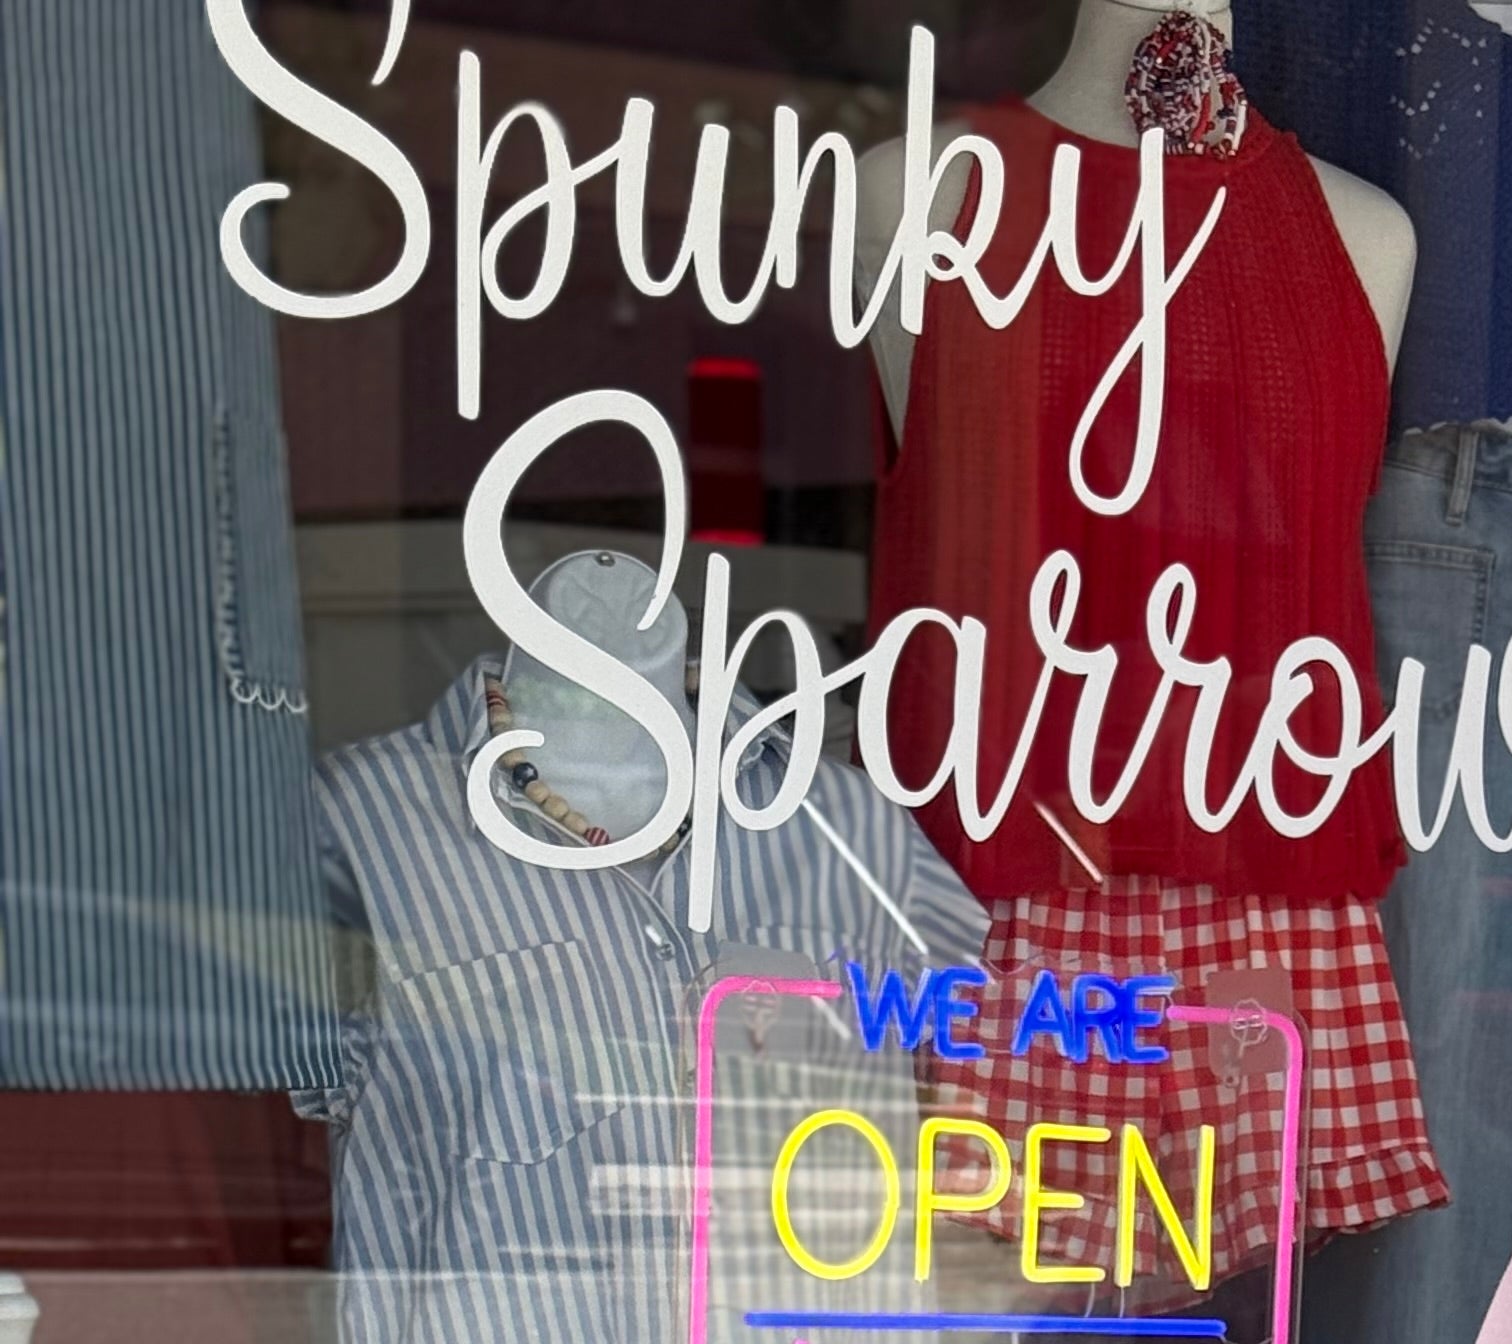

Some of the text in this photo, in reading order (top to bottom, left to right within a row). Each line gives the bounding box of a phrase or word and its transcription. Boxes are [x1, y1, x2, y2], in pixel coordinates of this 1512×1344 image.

[207, 0, 1227, 517] Spunky
[846, 960, 1177, 1064] WE ARE
[771, 1109, 1216, 1291] OPEN
